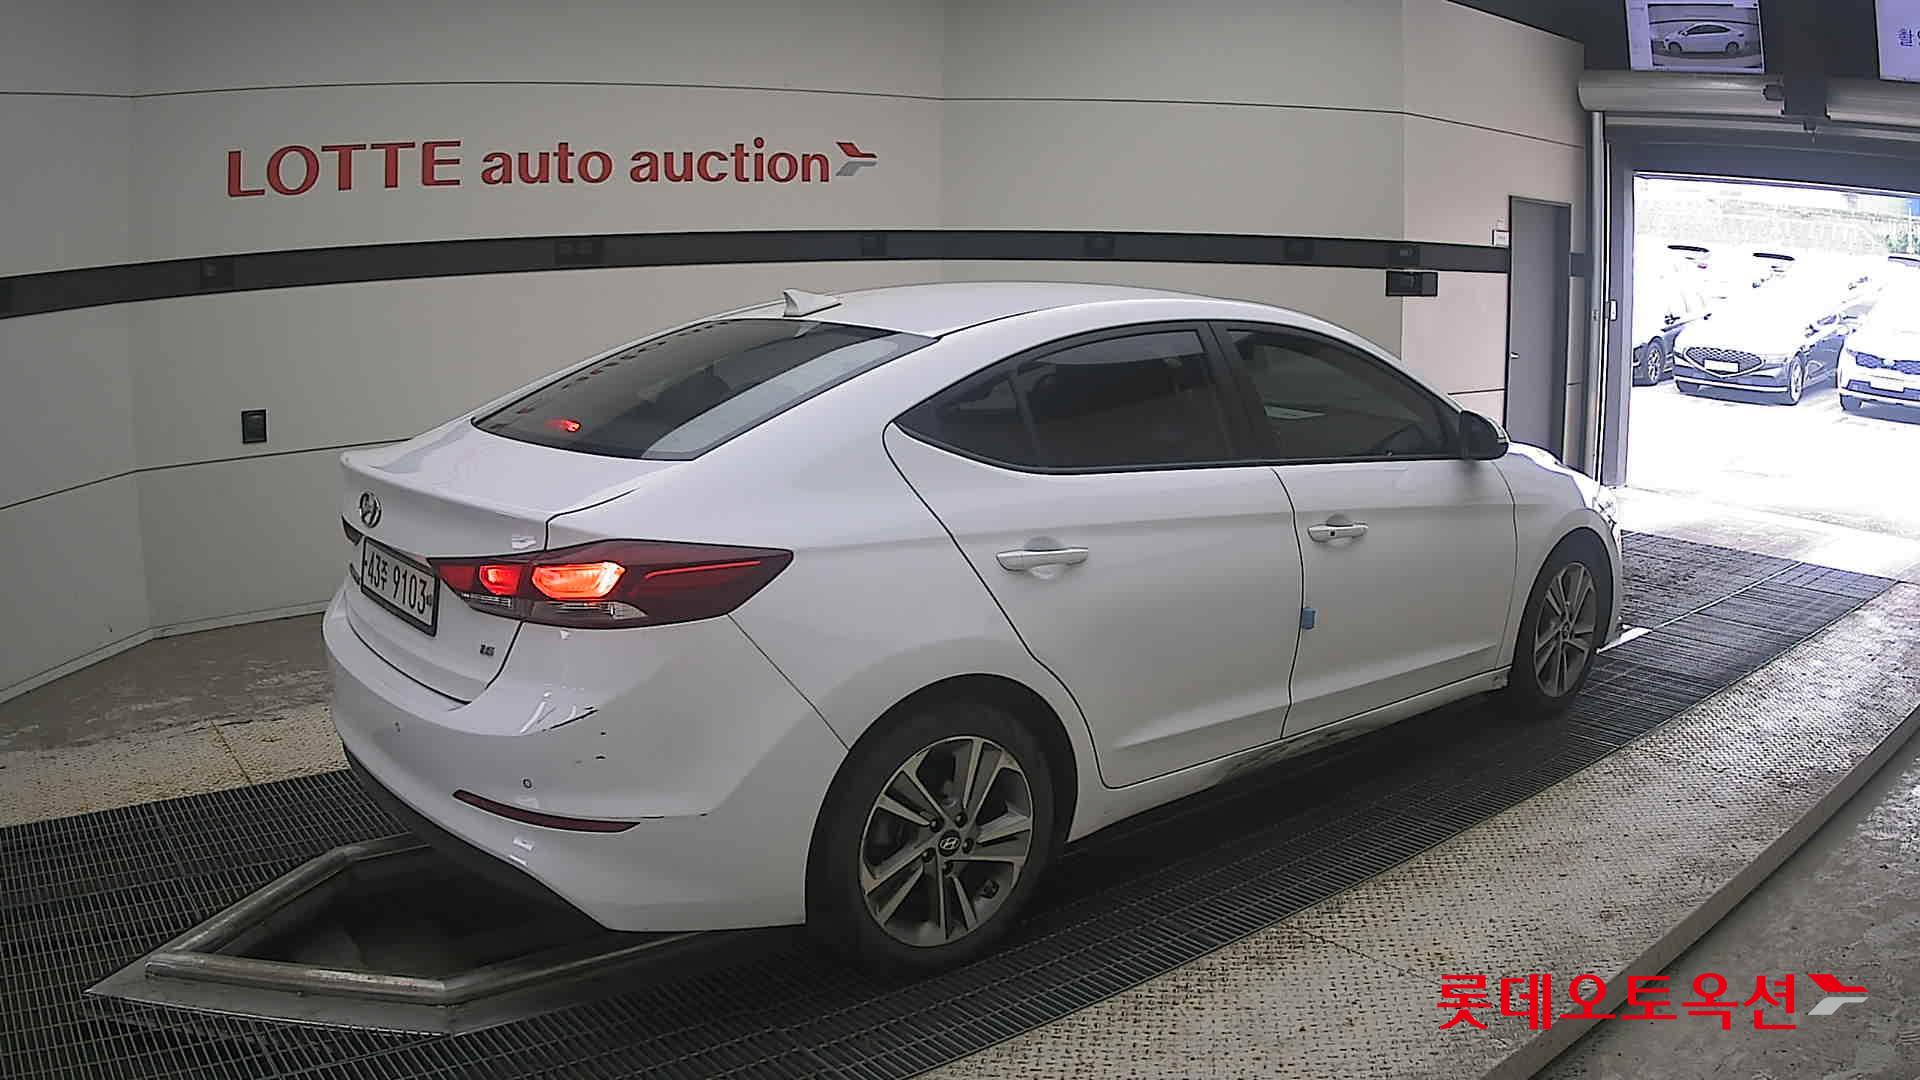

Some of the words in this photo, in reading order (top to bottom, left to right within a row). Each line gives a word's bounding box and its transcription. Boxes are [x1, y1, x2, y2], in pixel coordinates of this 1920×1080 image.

[227, 140, 461, 198] LOTTE
[480, 142, 613, 185] auto
[630, 137, 830, 183] auction
[393, 565, 427, 615] 9103
